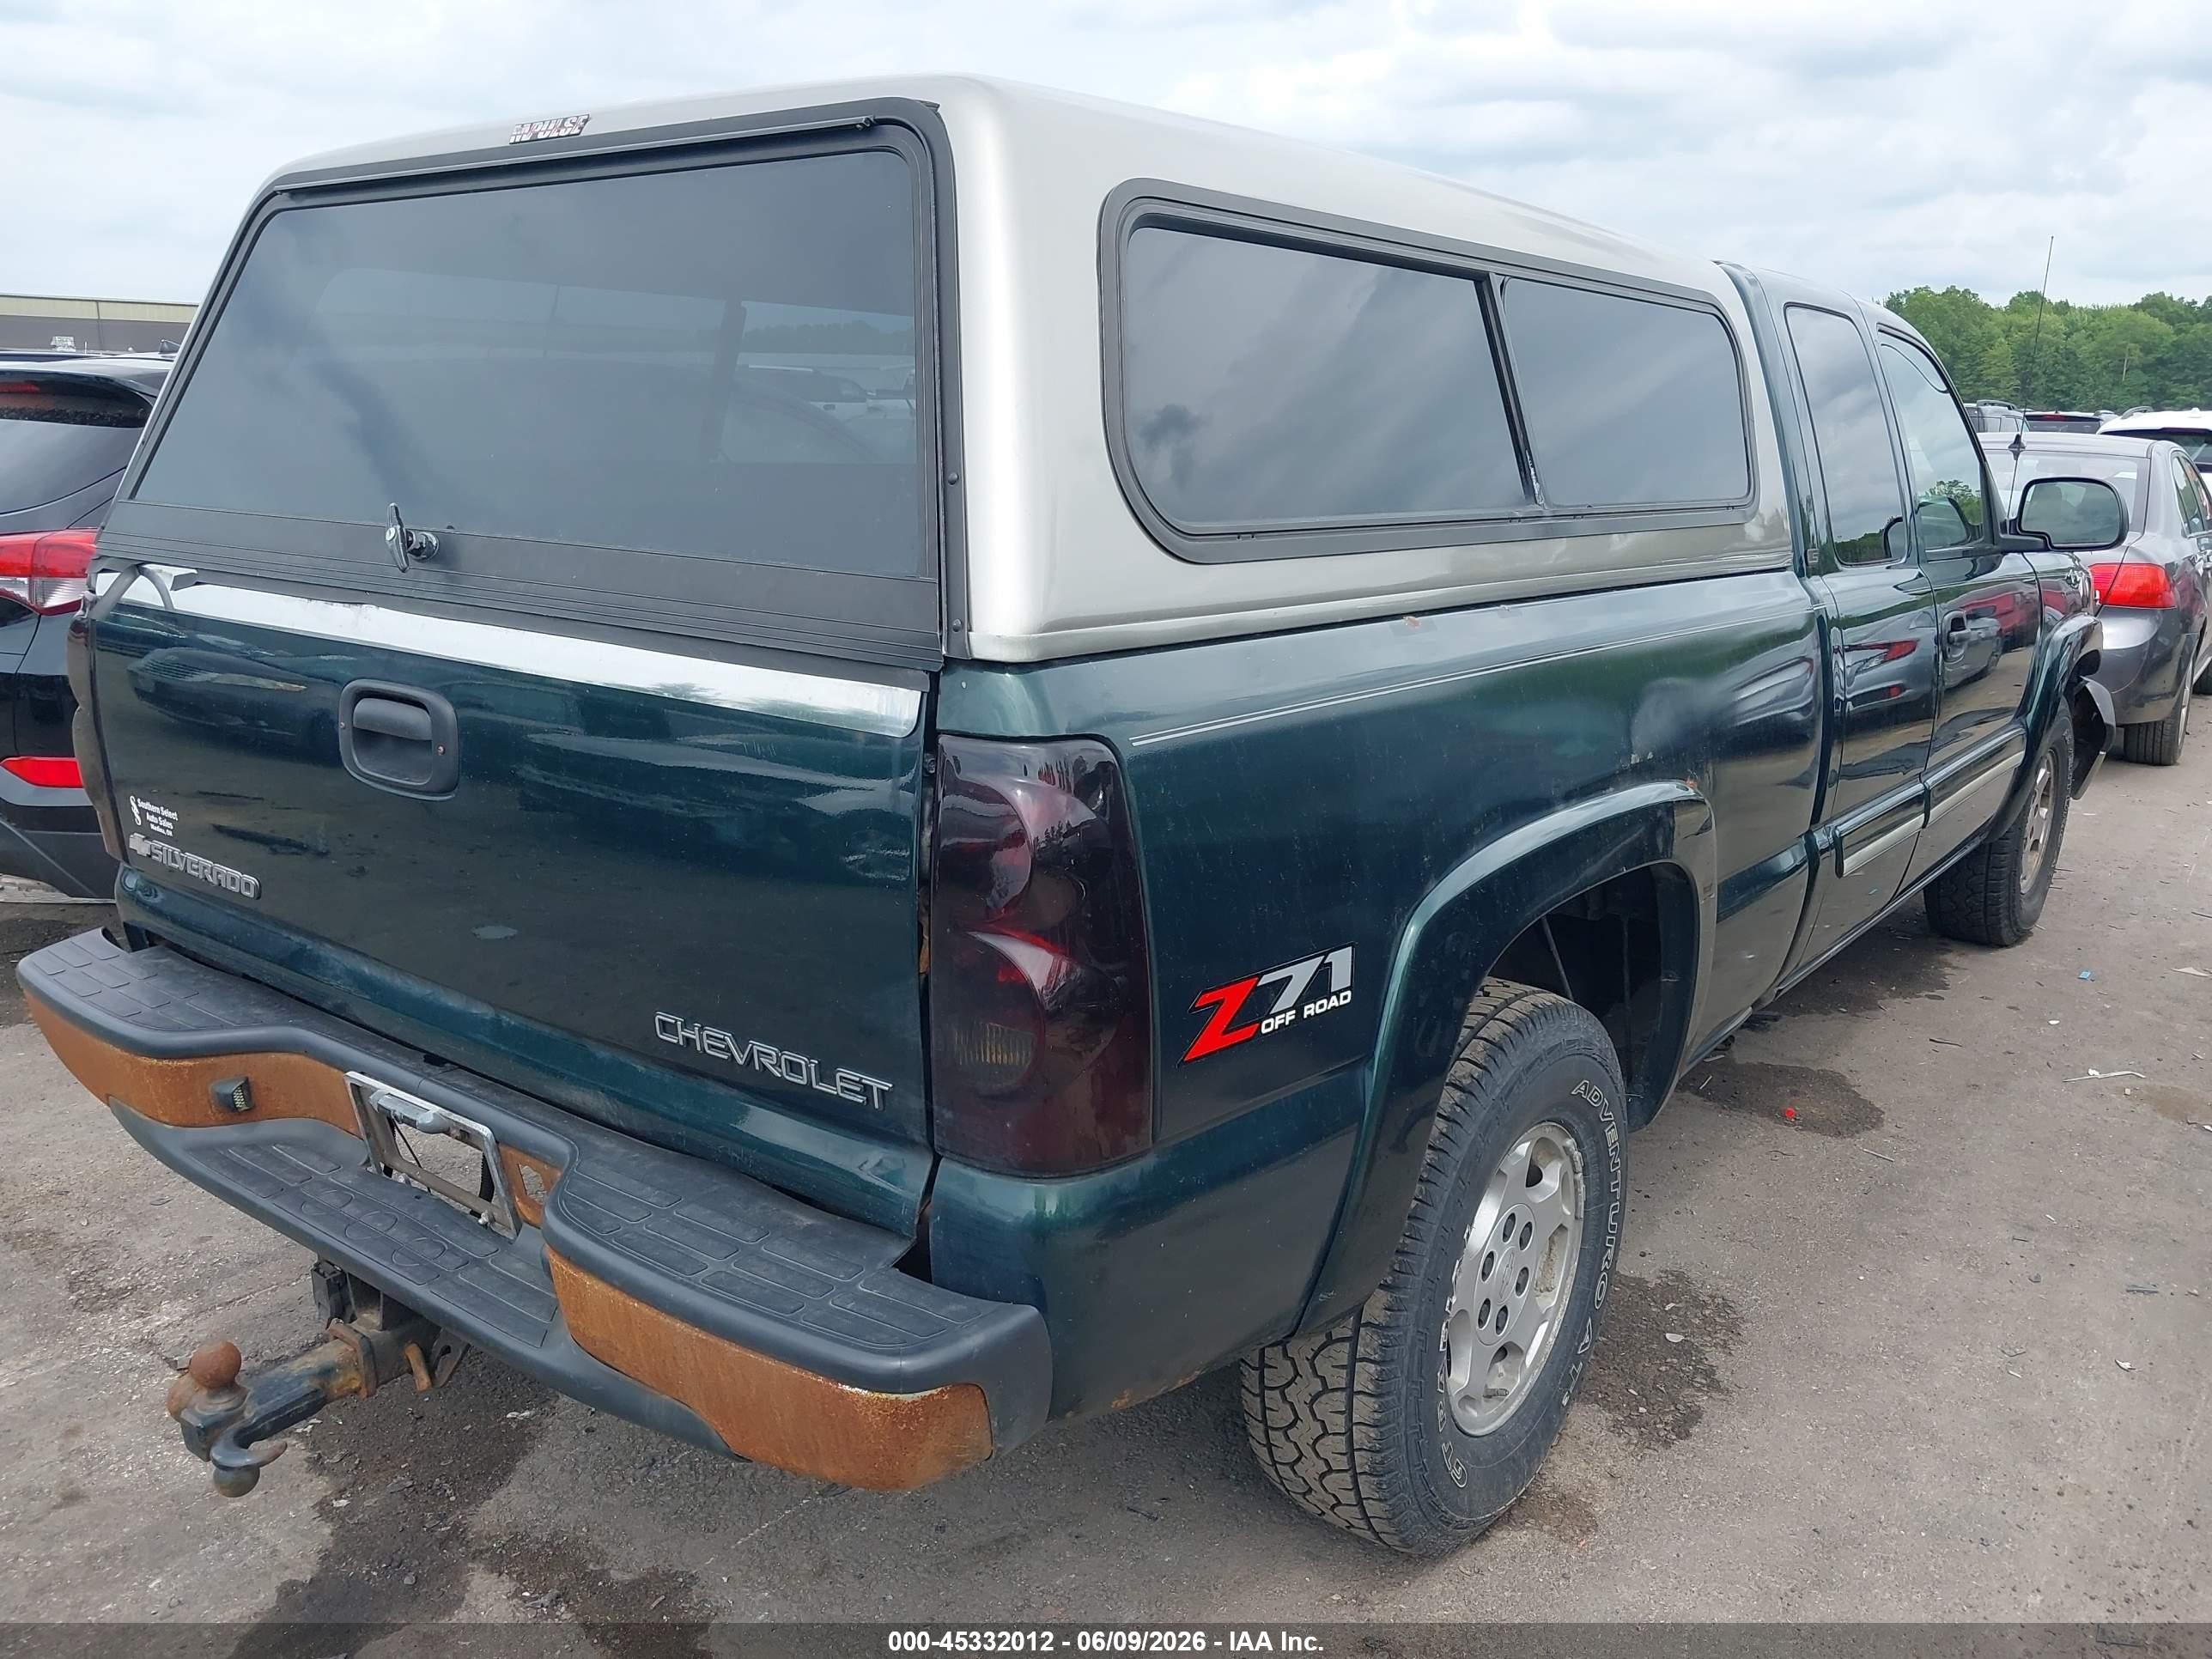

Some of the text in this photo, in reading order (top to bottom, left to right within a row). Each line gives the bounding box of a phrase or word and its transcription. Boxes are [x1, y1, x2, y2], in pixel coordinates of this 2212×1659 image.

[150, 839, 261, 899] SILVERADO
[1182, 945, 1353, 1063] Z71
[1261, 990, 1352, 1034] OFF ROAD
[654, 1011, 894, 1110] CHEVROLET
[1571, 1079, 1622, 1310] ADVENTURO
